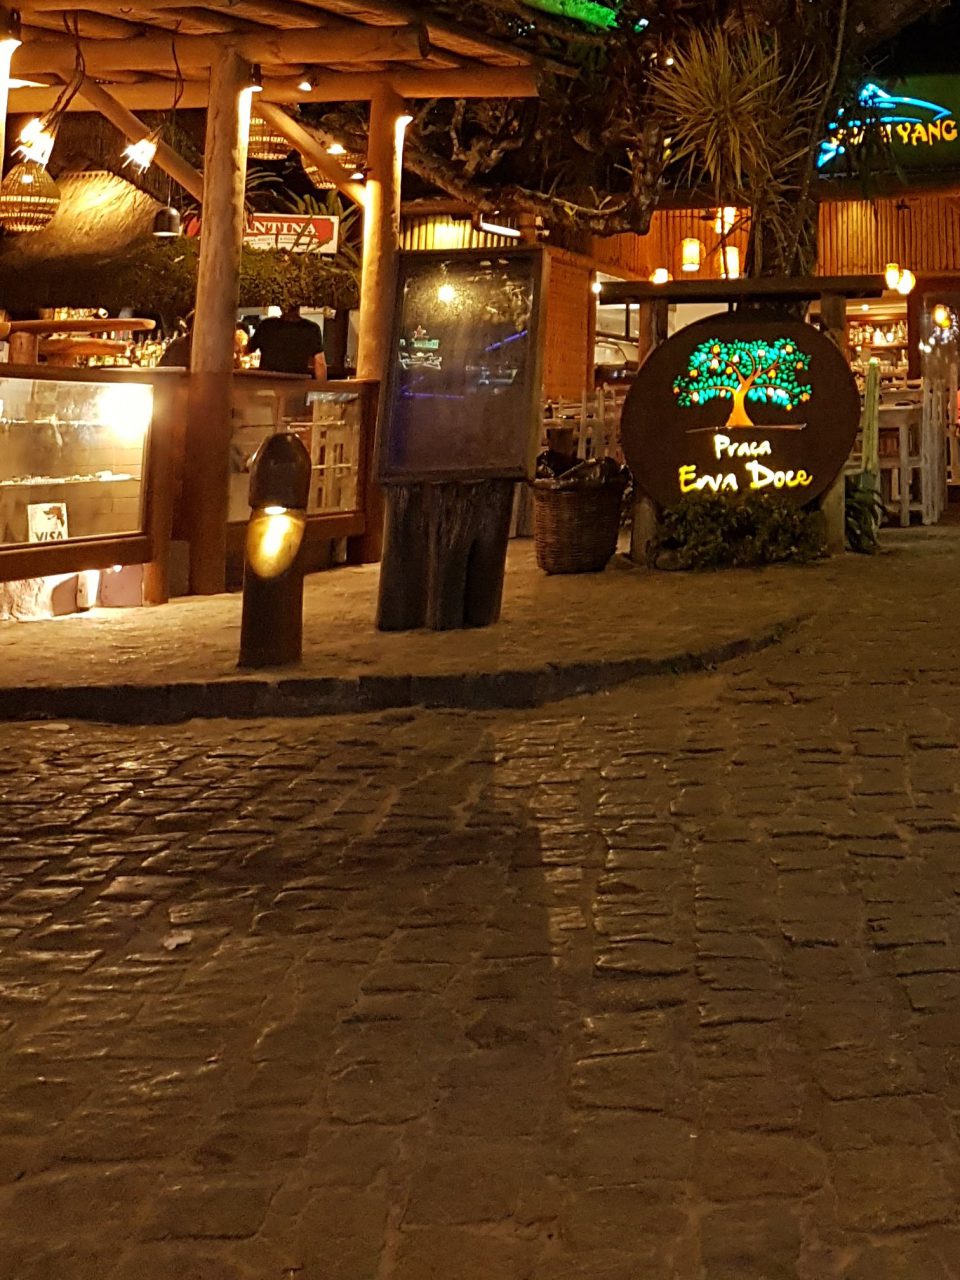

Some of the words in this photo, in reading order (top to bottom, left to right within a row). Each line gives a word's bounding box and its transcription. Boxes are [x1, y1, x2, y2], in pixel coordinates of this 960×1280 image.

[896, 119, 958, 146] YANG
[679, 464, 739, 494] Erva
[744, 459, 813, 490] Doce
[34, 531, 63, 541] VISA
